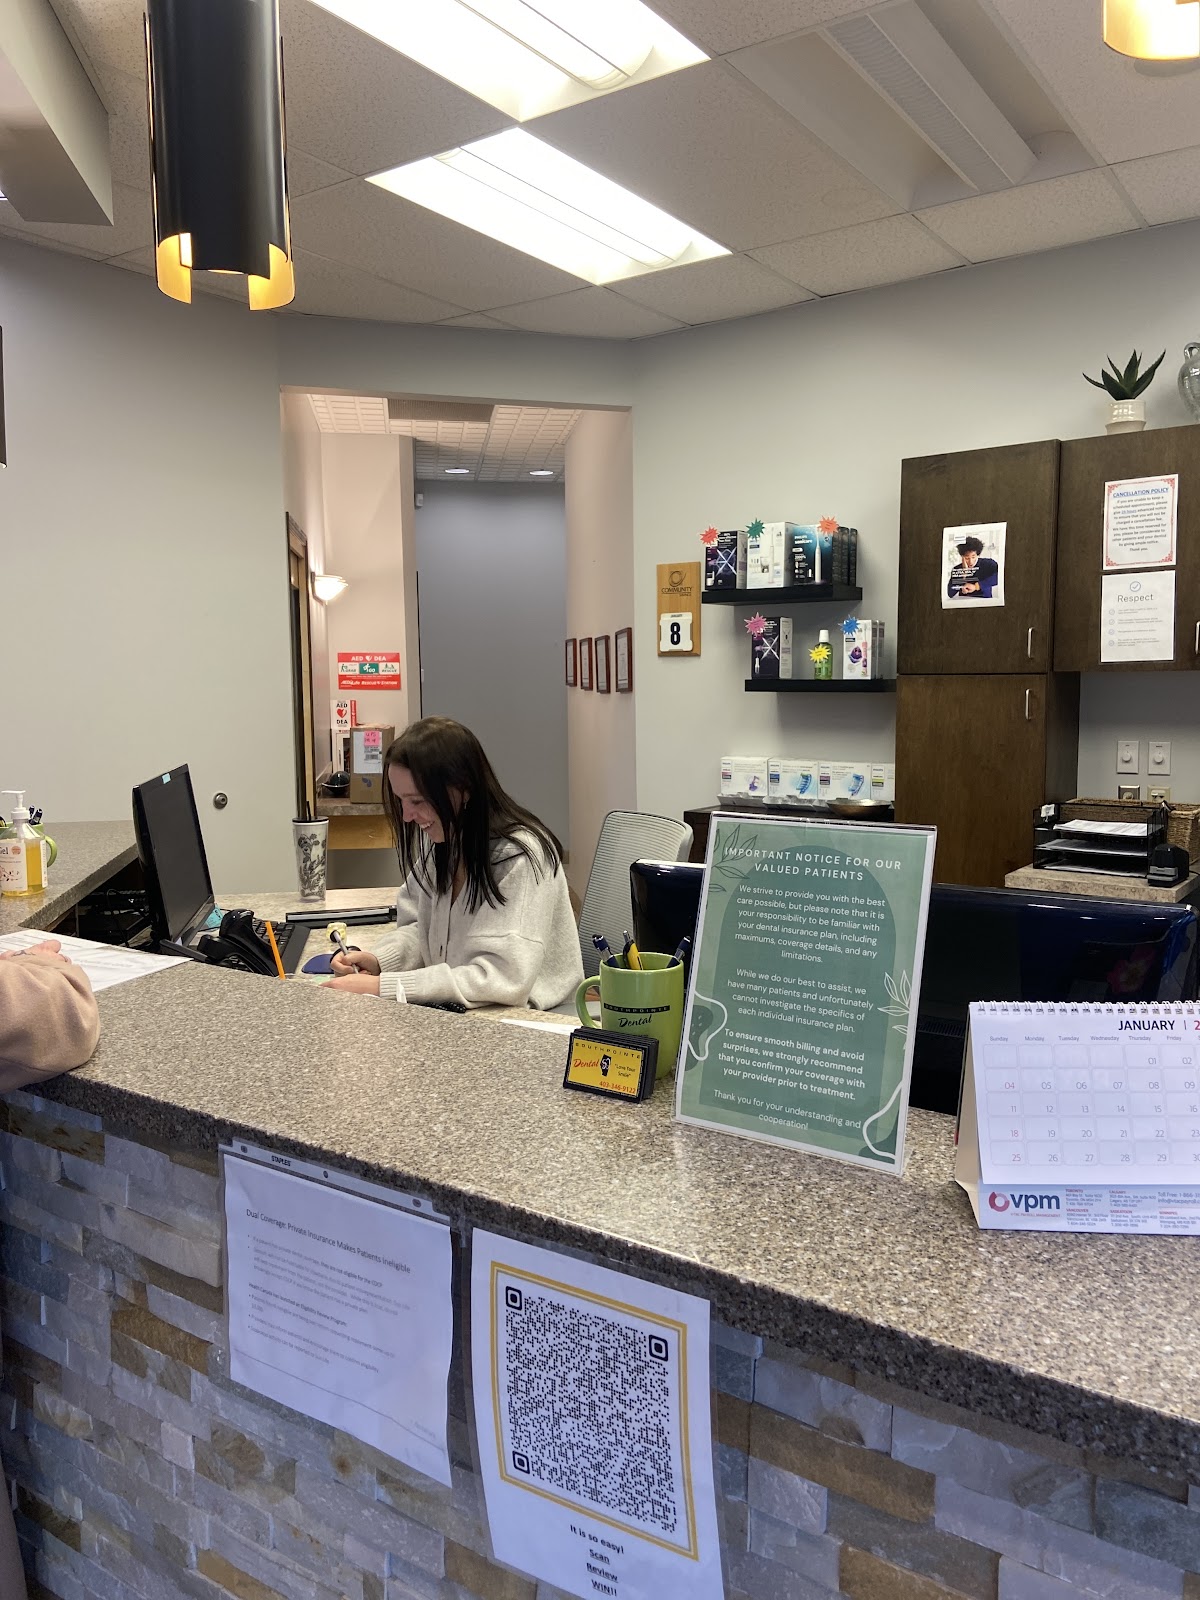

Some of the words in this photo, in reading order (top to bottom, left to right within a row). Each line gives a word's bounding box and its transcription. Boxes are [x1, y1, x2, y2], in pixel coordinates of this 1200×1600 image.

[1113, 490, 1150, 498] CANCELLATION
[1118, 594, 1153, 603] Respect
[670, 622, 680, 645] 8
[724, 846, 790, 859] IMPORTANT
[795, 852, 840, 863] NOTICE
[845, 856, 870, 866] FOR
[874, 859, 901, 869] OUR
[754, 863, 800, 874] VALUED
[804, 867, 863, 880] PATIENTS
[752, 885, 774, 894] strive
[784, 888, 814, 900] provide
[814, 893, 830, 902] you
[831, 893, 850, 902] with
[850, 895, 865, 904] the
[866, 897, 885, 906] best
[753, 898, 787, 910] possible,
[788, 902, 802, 910] but
[803, 903, 830, 914] please
[830, 906, 850, 915] note
[850, 908, 868, 917] that
[737, 910, 755, 918] your
[755, 910, 807, 924] responsibility
[818, 917, 829, 925] be
[830, 919, 861, 929] familiar
[861, 922, 880, 932] with
[737, 921, 754, 930] your
[755, 922, 780, 931] dental
[780, 925, 819, 936] insurance
[819, 930, 839, 940] plan,
[839, 932, 878, 945] including
[734, 931, 776, 944] maximums,
[777, 939, 813, 950] coverage
[814, 942, 843, 953] details,
[844, 946, 861, 955] and
[861, 950, 877, 958] any
[781, 949, 823, 962] limitations.
[736, 968, 757, 977] While
[770, 973, 782, 981] do
[797, 977, 816, 986] best
[816, 980, 826, 988] to
[827, 981, 853, 993] assist,
[726, 979, 745, 988] have
[746, 984, 767, 994] many
[768, 986, 801, 999] patients
[801, 991, 818, 1000] and
[818, 993, 874, 1011] unfortunately
[731, 992, 758, 1003] cannot
[759, 996, 802, 1012] investigate
[802, 1004, 817, 1012] the
[817, 1006, 855, 1020] specifics
[855, 1012, 865, 1020] of
[618, 1014, 653, 1027] Dental
[737, 1006, 756, 1015] each
[757, 1009, 794, 1022] individual
[795, 1015, 834, 1029] insurance
[835, 1022, 856, 1034] plan.
[1118, 1020, 1175, 1030] JANUARY
[575, 1043, 640, 1059] SOUTHPOINTE
[724, 1028, 734, 1036] To
[735, 1032, 762, 1042] ensure
[763, 1035, 795, 1048] smooth
[795, 1041, 821, 1054] billing
[822, 1046, 839, 1056] and
[840, 1049, 864, 1060] avoid
[574, 1058, 599, 1068] Dental
[722, 1040, 761, 1056] surprises,
[774, 1050, 809, 1065] strongly
[810, 1057, 863, 1074] recommend
[717, 1052, 734, 1062] that
[734, 1057, 750, 1066] you
[751, 1058, 784, 1072] confirm
[784, 1067, 804, 1077] your
[804, 1071, 844, 1085] coverage
[845, 1077, 866, 1088] with
[722, 1067, 741, 1077] your
[741, 1069, 777, 1085] provider
[777, 1076, 798, 1089] prior
[798, 1081, 808, 1090] to
[809, 1083, 856, 1100] treatment.
[713, 1089, 736, 1101] Thank
[736, 1096, 751, 1106] you
[752, 1098, 764, 1107] for
[764, 1102, 783, 1112] your
[784, 1104, 843, 1126] understanding
[844, 1118, 861, 1128] and
[758, 1112, 808, 1131] cooperation!
[272, 1155, 291, 1166] STAPLES
[1010, 1194, 1060, 1212] vpm
[246, 1209, 259, 1219] Dual
[260, 1214, 286, 1228] Coverage:
[288, 1223, 307, 1235] Private
[308, 1230, 335, 1246] Insurance
[337, 1240, 356, 1253] Makes
[357, 1248, 381, 1263] Patients
[570, 1524, 577, 1534] It
[578, 1528, 586, 1538] is
[588, 1532, 598, 1543] so
[600, 1539, 624, 1554] easy!
[589, 1549, 610, 1564] Scan
[586, 1562, 618, 1582] Review
[591, 1579, 617, 1596] WIN!!
